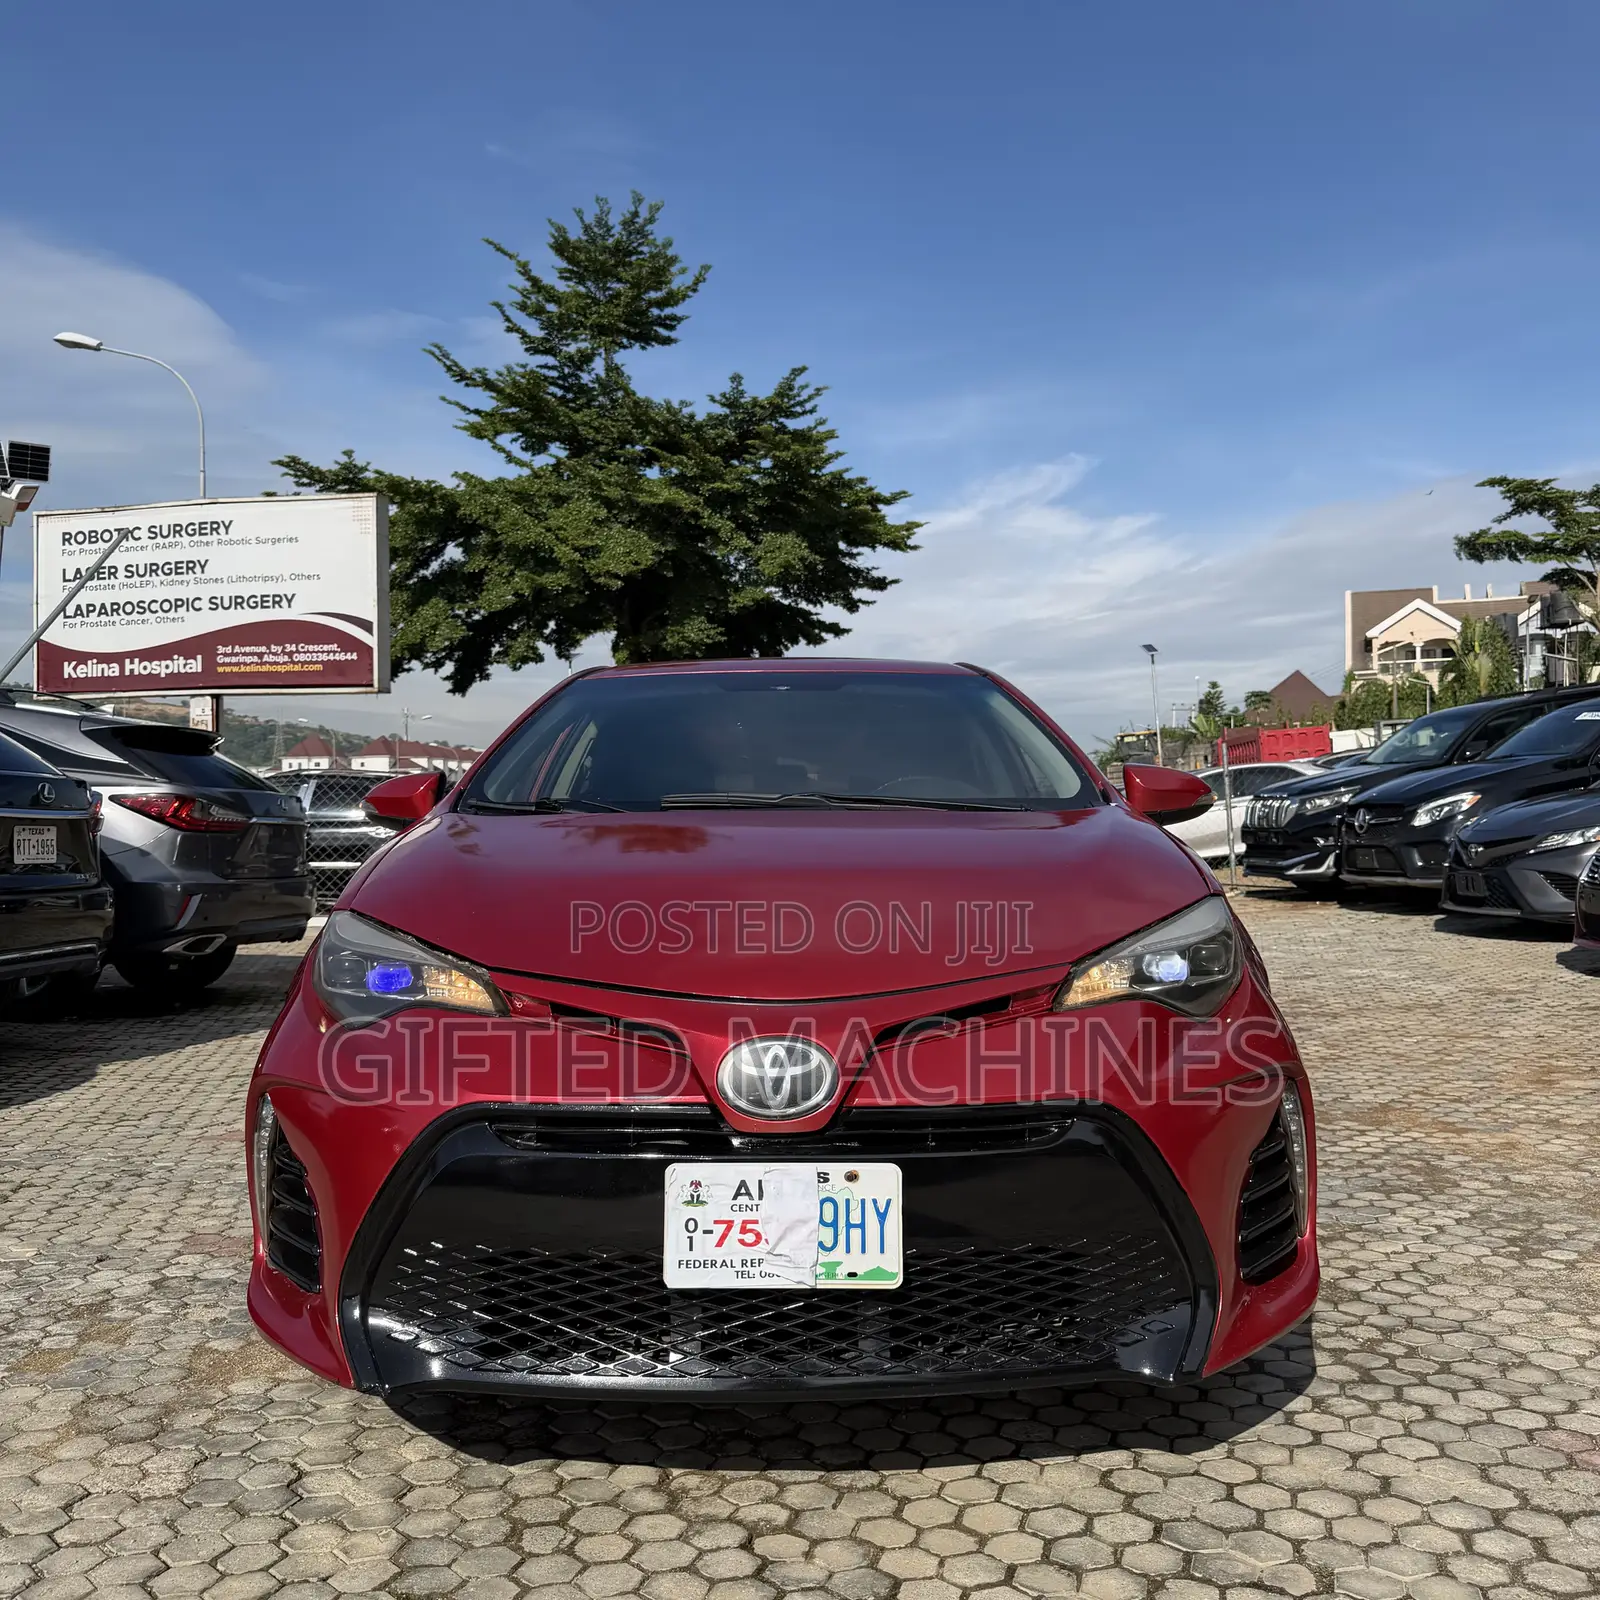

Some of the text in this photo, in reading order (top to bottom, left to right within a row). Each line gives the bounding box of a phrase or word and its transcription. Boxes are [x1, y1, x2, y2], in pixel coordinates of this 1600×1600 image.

[147, 520, 234, 540] SURGERY
[62, 548, 76, 557] For
[118, 543, 149, 553] Cancer
[188, 538, 214, 548] Other
[217, 536, 253, 546] Robotic
[254, 534, 299, 546] Surgeries
[124, 559, 209, 579] SURGERY
[62, 584, 74, 593] Fo
[83, 582, 116, 592] rostate
[159, 578, 190, 588] Kidney
[193, 576, 224, 585] Stones
[289, 572, 321, 581] Others
[63, 593, 297, 619] LAPAROSCOPIC SURGERY
[63, 615, 185, 629] For Prostate Cancer, Others
[216, 645, 231, 654] 3rd
[271, 644, 283, 654] by
[284, 643, 297, 652] 34
[298, 643, 341, 652] Crescent,
[63, 654, 203, 679] Kelina Hospital
[216, 663, 324, 673] www.kelinahospital.com
[28, 828, 45, 836] TEXAS
[677, 1259, 737, 1270] FEDERAL
[734, 1270, 756, 1280] TEL:
